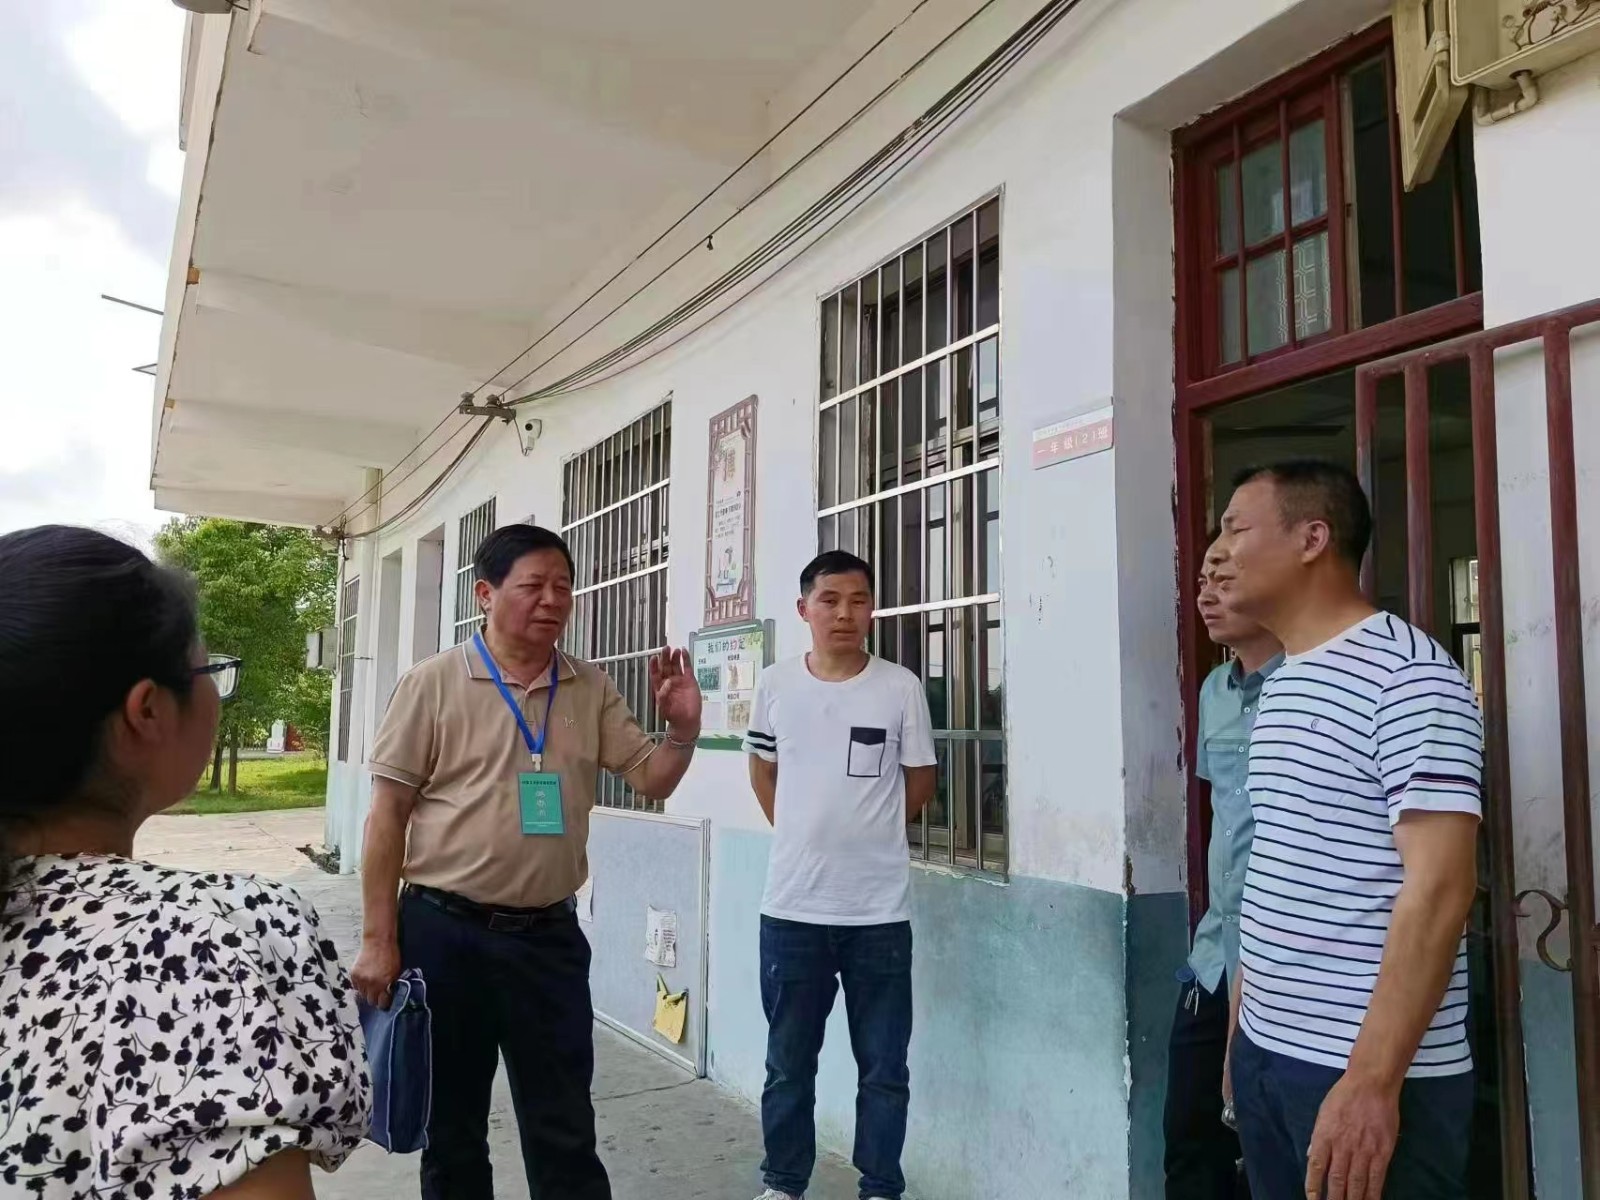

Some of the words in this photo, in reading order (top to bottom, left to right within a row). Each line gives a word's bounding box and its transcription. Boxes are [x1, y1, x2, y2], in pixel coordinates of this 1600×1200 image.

[708, 635, 745, 654] 我们的约定
